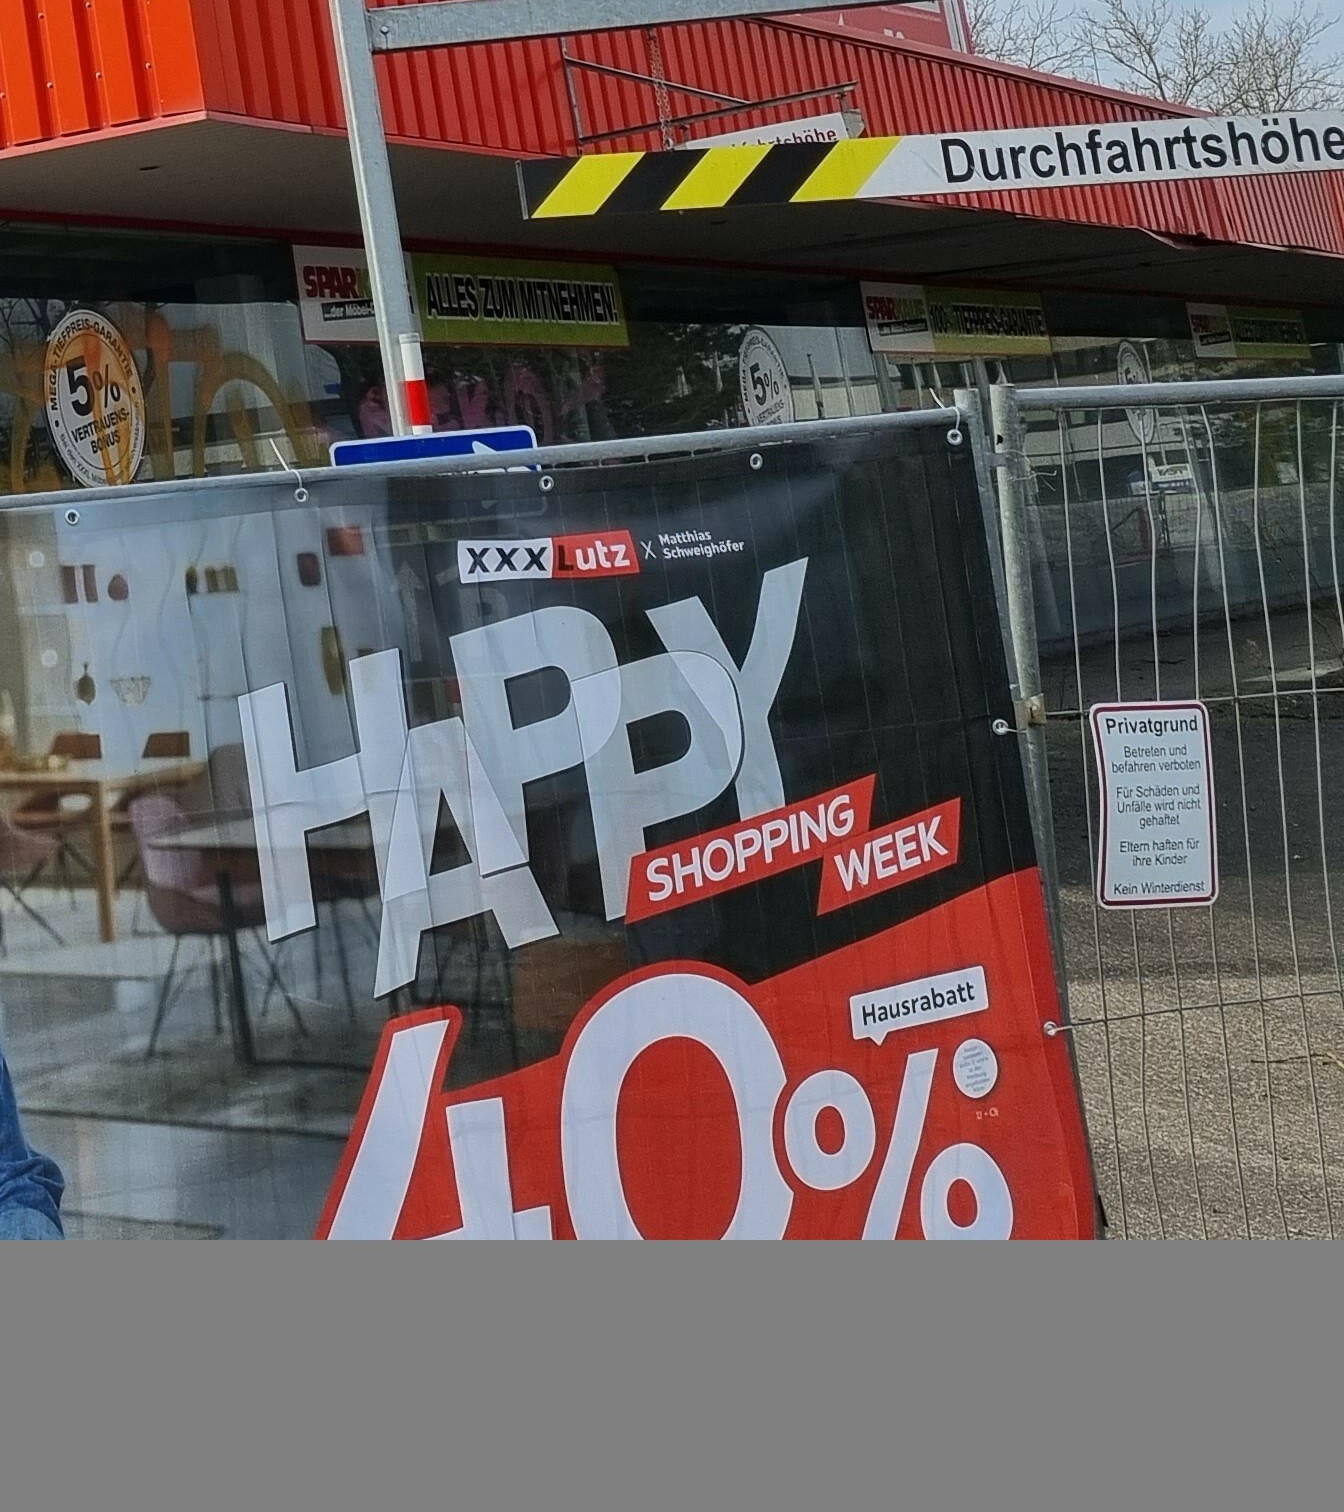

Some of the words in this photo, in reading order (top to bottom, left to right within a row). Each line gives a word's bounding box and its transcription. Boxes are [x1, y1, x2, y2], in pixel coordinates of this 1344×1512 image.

[940, 117, 1344, 184] Durchfahrtshöhe
[426, 275, 479, 319] ALLES
[479, 278, 516, 321] ZUM
[519, 281, 619, 324] MITNEHMEN!
[66, 354, 121, 417] 5%
[749, 362, 780, 406] 5%
[71, 407, 130, 443] VERTRAUENS-
[90, 430, 121, 455] BONUS
[658, 529, 712, 546] Matthias
[662, 539, 745, 561] Schweighöfer
[1105, 715, 1199, 737] Privatgrund
[1123, 745, 1167, 758] Betreten
[1168, 744, 1187, 756] und
[238, 555, 808, 999] HAPPY
[1111, 761, 1156, 774] befahren
[1158, 759, 1201, 771] verboten
[1116, 786, 1133, 799] Für
[1135, 785, 1180, 798] Schäden
[1181, 784, 1200, 796] und
[1117, 801, 1152, 814] Unfälle
[1154, 800, 1175, 812] wird
[1177, 799, 1201, 811] nicht
[1139, 814, 1180, 830] gehaftet
[645, 794, 855, 902] SHOPPING
[833, 815, 949, 892] WEEK
[1119, 840, 1150, 853] Eltern
[1152, 839, 1184, 851] haften
[1186, 837, 1200, 850] für
[1132, 855, 1152, 867] ihre
[1154, 854, 1188, 866] Kinder
[1113, 883, 1138, 895] Kein
[1140, 881, 1205, 894] Winterdienst
[861, 981, 976, 1026] Hausrabatt
